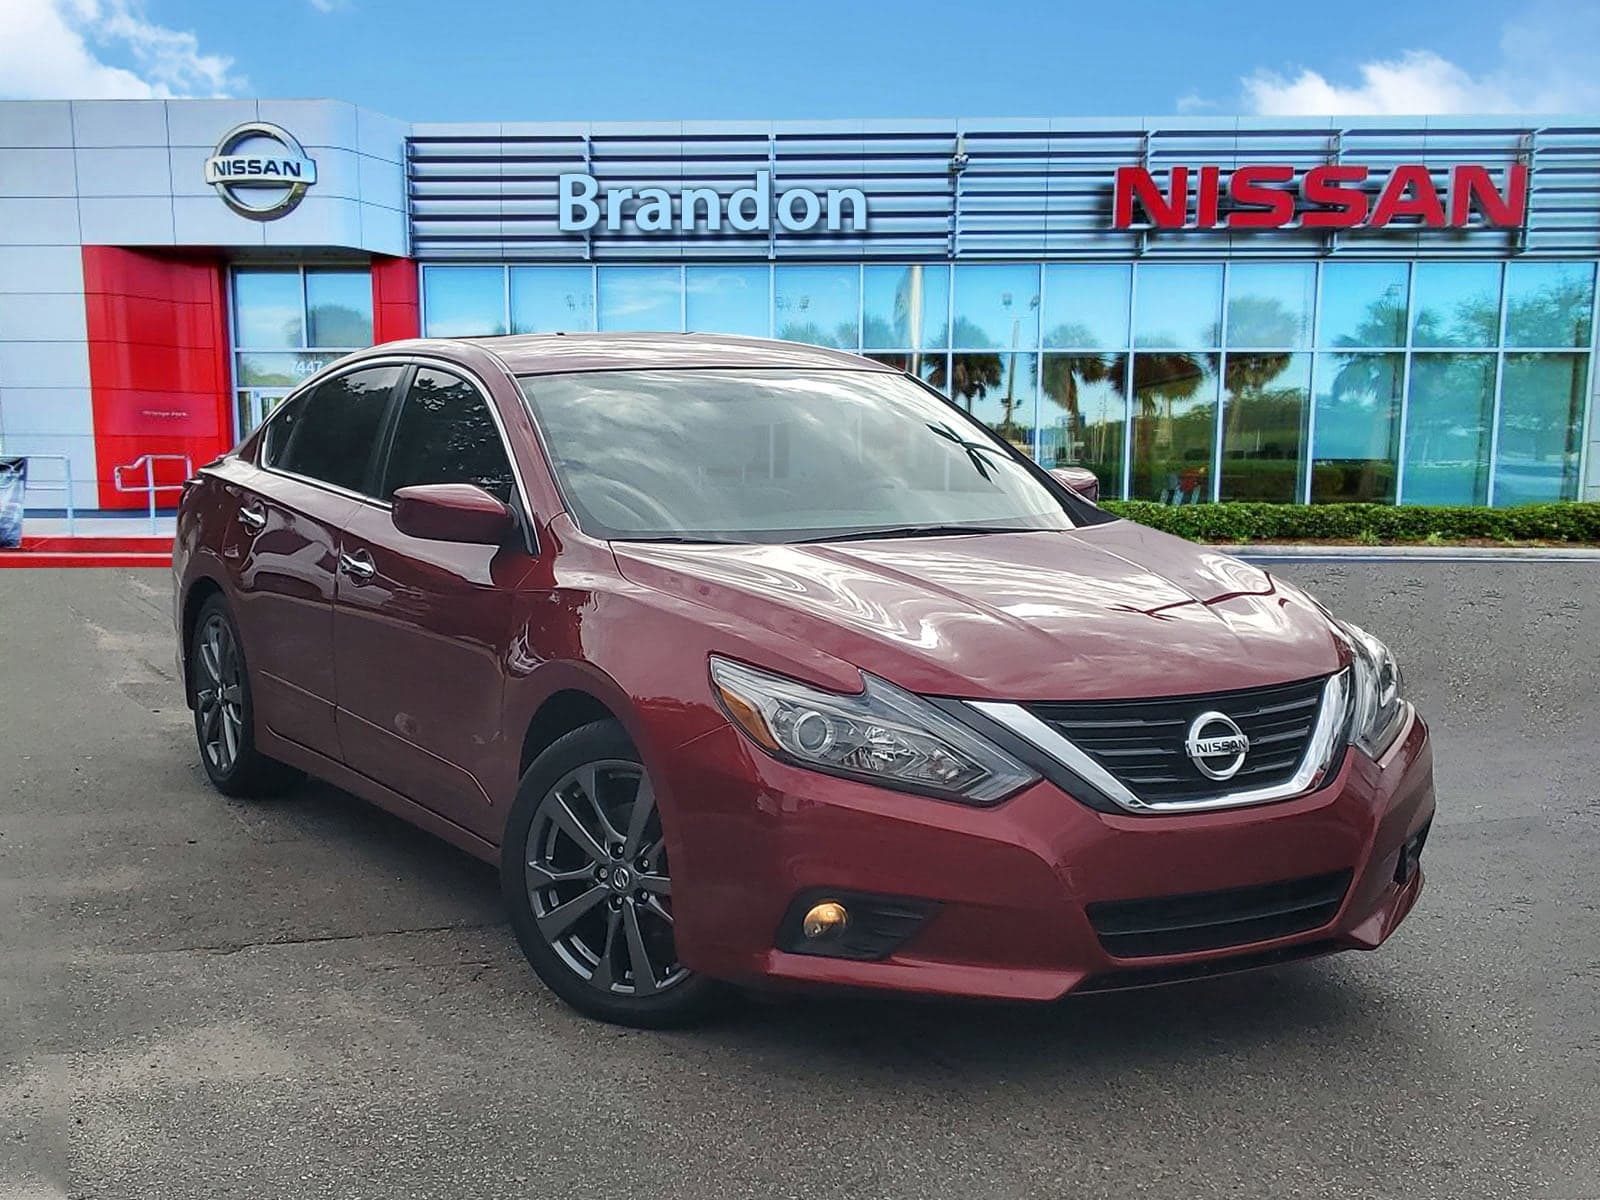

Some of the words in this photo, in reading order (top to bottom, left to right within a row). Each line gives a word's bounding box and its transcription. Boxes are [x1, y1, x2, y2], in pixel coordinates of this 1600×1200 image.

[213, 159, 301, 177] NISSAN
[558, 170, 867, 232] Brandon
[1113, 164, 1528, 229] NISSAN
[1196, 739, 1247, 754] NISSAN
